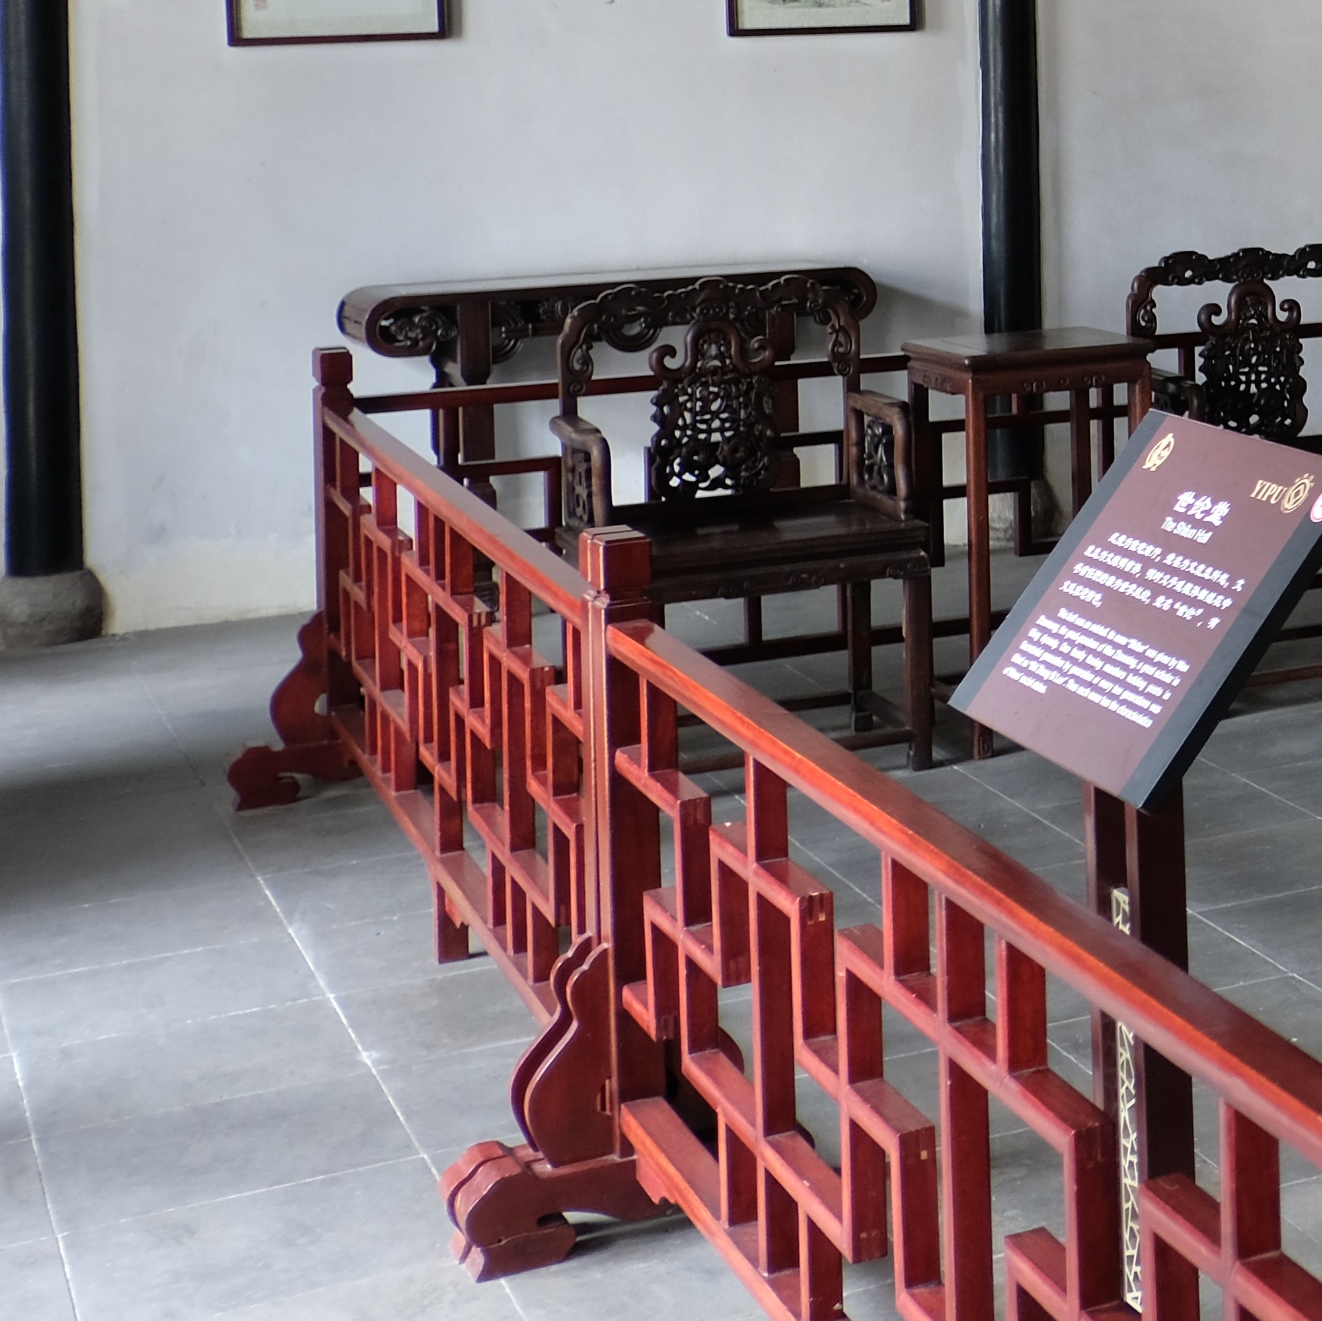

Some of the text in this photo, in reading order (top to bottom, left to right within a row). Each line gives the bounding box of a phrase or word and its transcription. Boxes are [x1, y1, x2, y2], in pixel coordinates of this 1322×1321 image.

[1250, 479, 1288, 505] YIPU
[1172, 490, 1230, 526] 世纶堂
[1160, 516, 1177, 532] The
[1192, 528, 1213, 544] Hall
